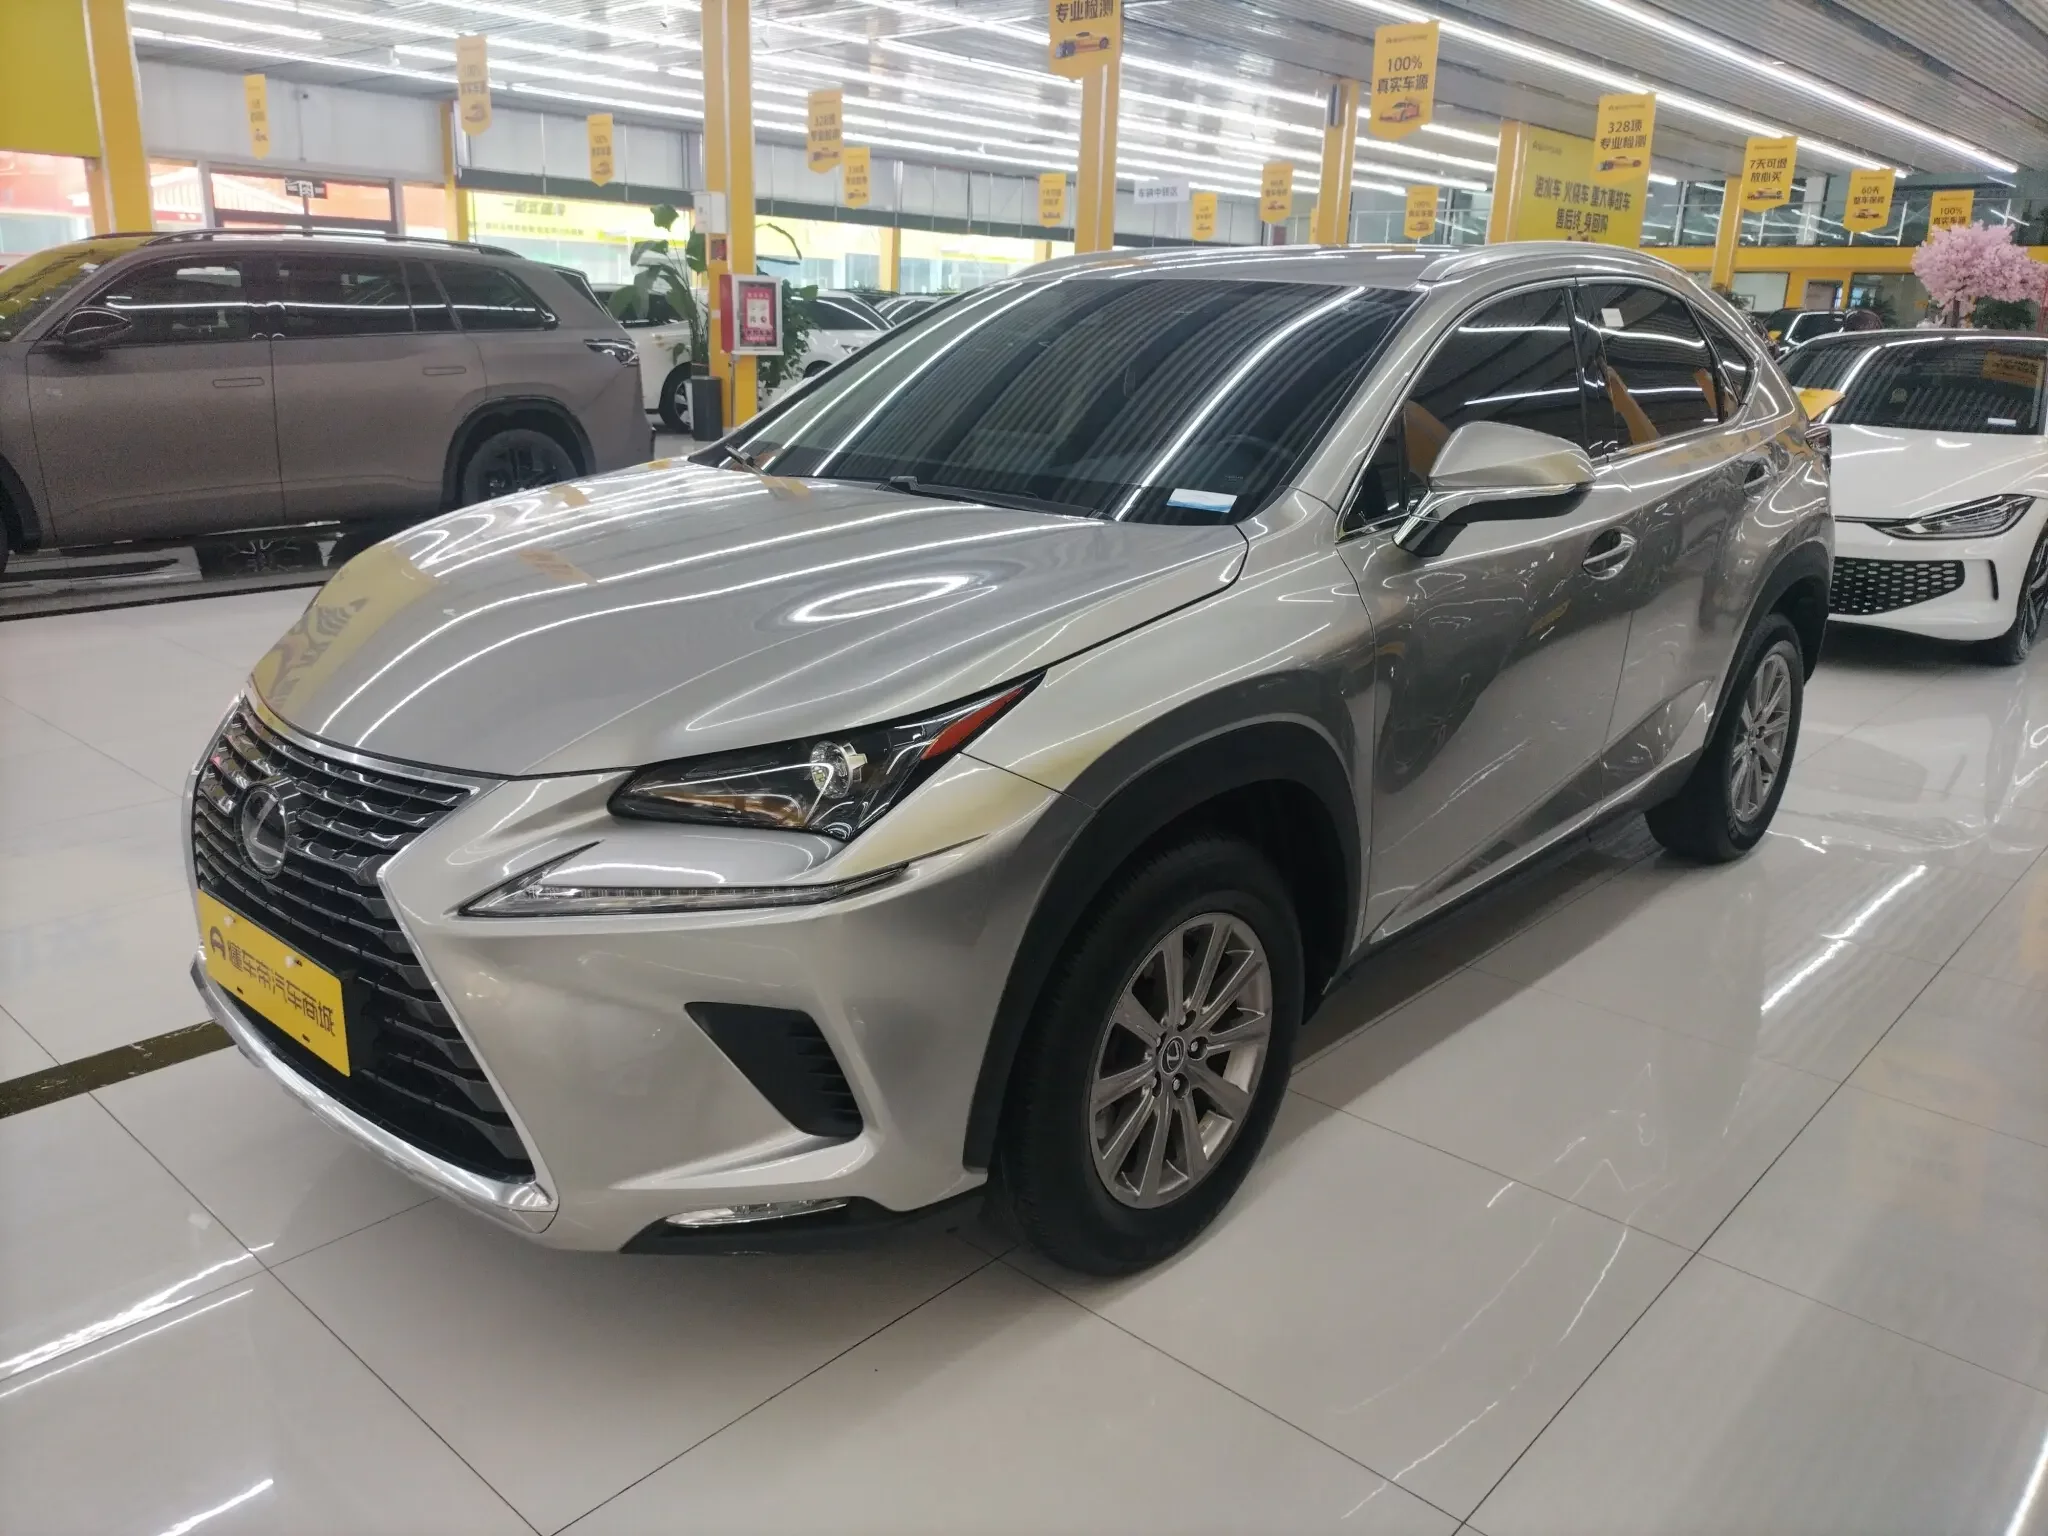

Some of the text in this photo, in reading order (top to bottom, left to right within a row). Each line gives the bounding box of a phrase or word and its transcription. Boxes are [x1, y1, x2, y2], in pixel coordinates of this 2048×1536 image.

[1056, 0, 1114, 23] 专业检测
[1388, 56, 1423, 72] 100%
[1376, 74, 1428, 94] 真实车源
[1607, 119, 1642, 134] 328项
[1600, 134, 1647, 150] 专业检测
[1750, 157, 1787, 170] 7天可退
[1751, 171, 1782, 183] 放心买
[1534, 174, 1631, 212] 泡水车 火烧车 重大事故车
[1940, 207, 1962, 215] 100%
[227, 940, 336, 1037] 懂车帝汽车商城
